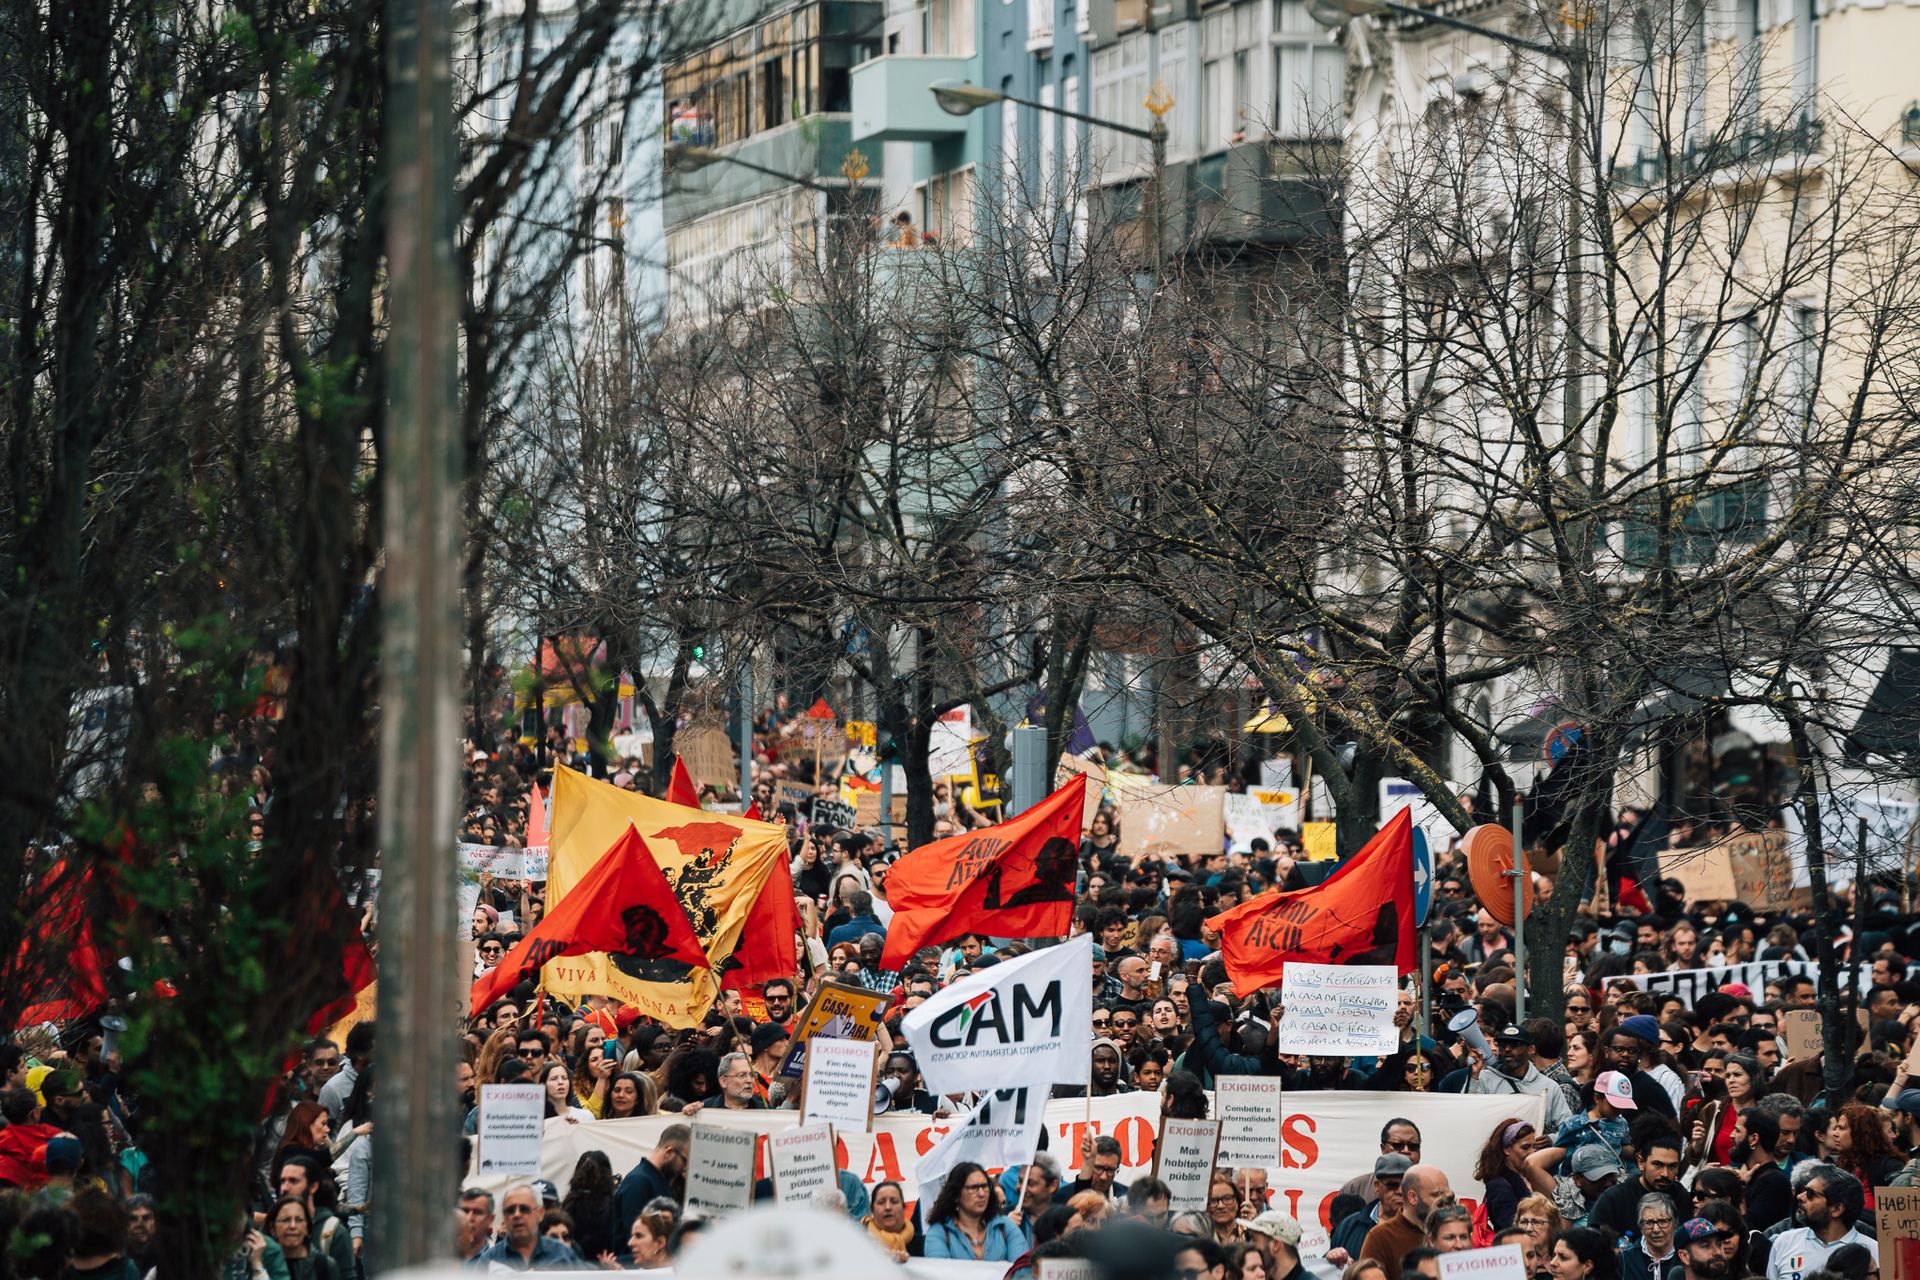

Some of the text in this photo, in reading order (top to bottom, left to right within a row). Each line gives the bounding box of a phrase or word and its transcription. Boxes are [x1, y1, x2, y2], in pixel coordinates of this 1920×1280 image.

[556, 967, 596, 982] VIVA
[614, 983, 676, 1015] COMUNA
[1298, 992, 1322, 1001] CASA
[821, 998, 849, 1016] CASA
[841, 1021, 870, 1039] PARA
[1301, 1022, 1328, 1032] CASA
[815, 1045, 870, 1057] EXIGIMOS
[1221, 1082, 1276, 1093] EXIGIMOS
[486, 1092, 541, 1100] EXIGIMOS
[1225, 1105, 1264, 1113] Combater
[1221, 1115, 1276, 1123] informalidade
[1168, 1126, 1215, 1137] EXIGIMOS
[1242, 1125, 1253, 1133] do
[695, 1131, 751, 1146] EXIGIMOS
[775, 1132, 827, 1147] EXIGIMOS
[1220, 1135, 1276, 1143] arrendamento
[1179, 1146, 1200, 1155] Mais
[793, 1154, 816, 1163] Mais
[1164, 1158, 1209, 1170] habitação
[779, 1164, 831, 1178] alojamento
[701, 1175, 746, 1189] Habitação
[1169, 1172, 1201, 1182] pública
[790, 1178, 824, 1189] público
[1446, 1256, 1518, 1274] EXIGIMOS
